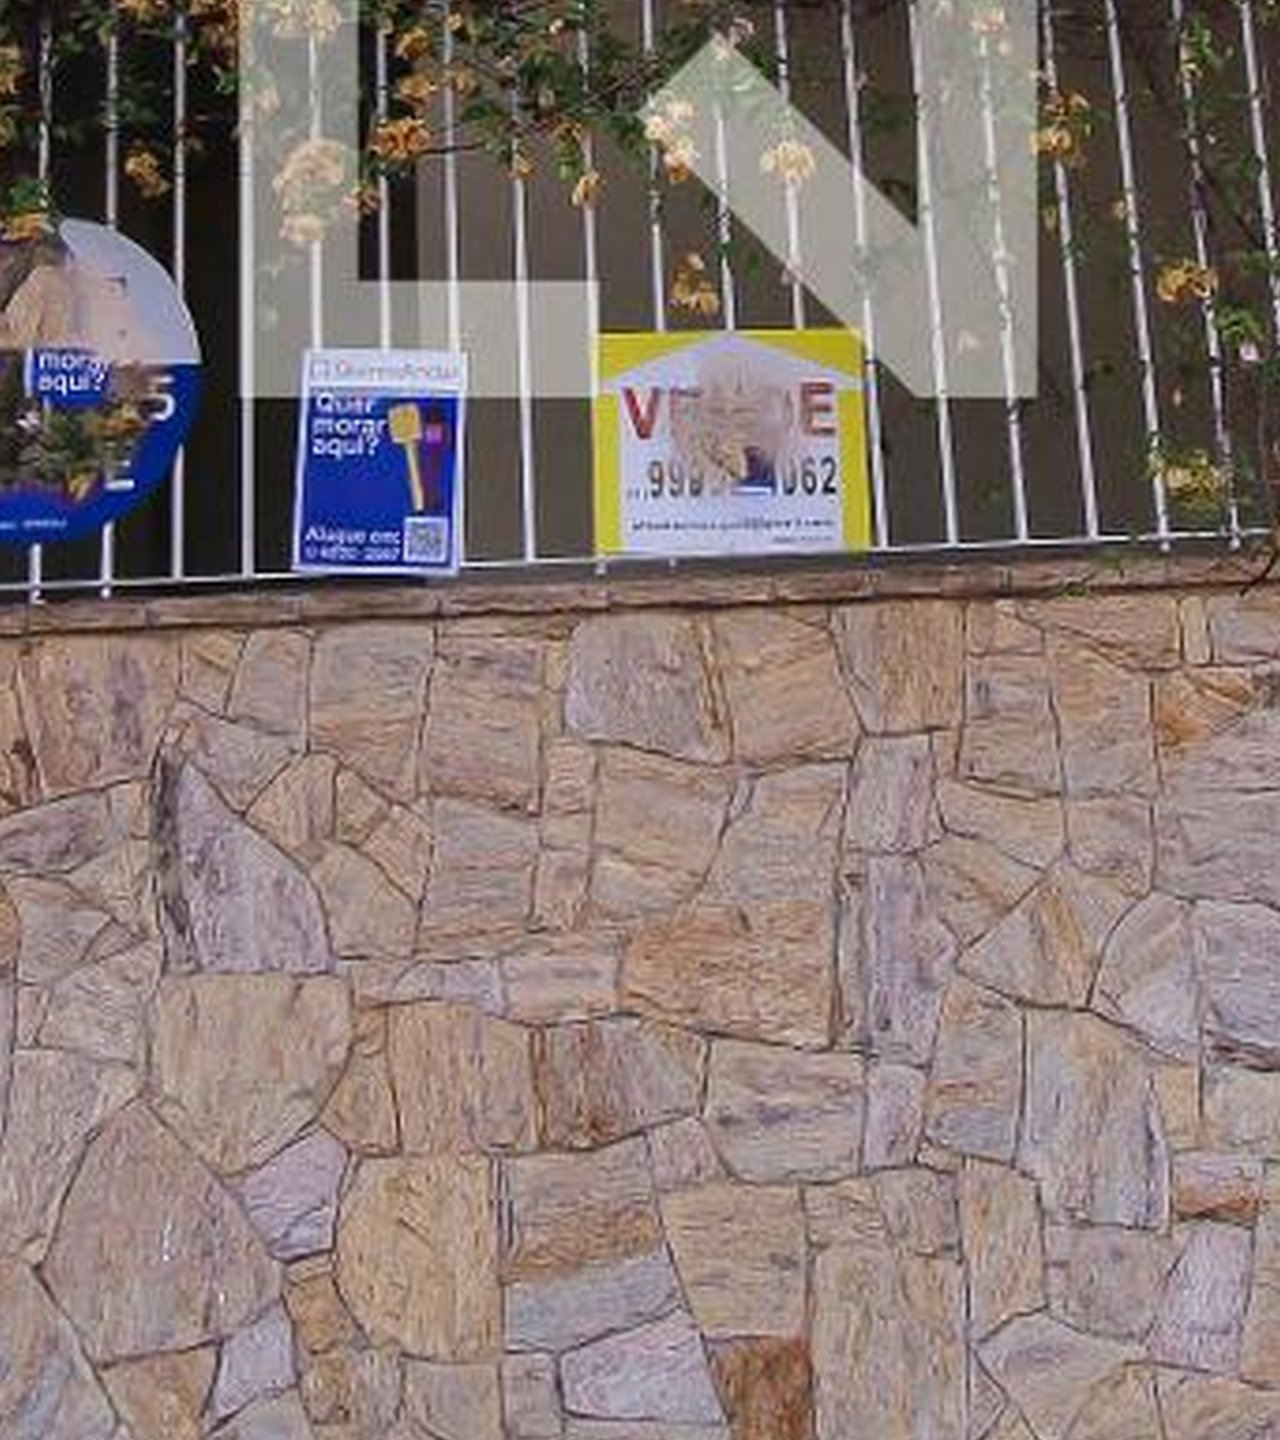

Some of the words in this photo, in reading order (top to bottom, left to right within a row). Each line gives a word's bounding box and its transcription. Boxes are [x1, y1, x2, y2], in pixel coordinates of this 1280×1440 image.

[38, 372, 105, 396] aqui?
[316, 392, 376, 414] Quer
[312, 417, 389, 437] morar
[312, 434, 381, 460] aqui?
